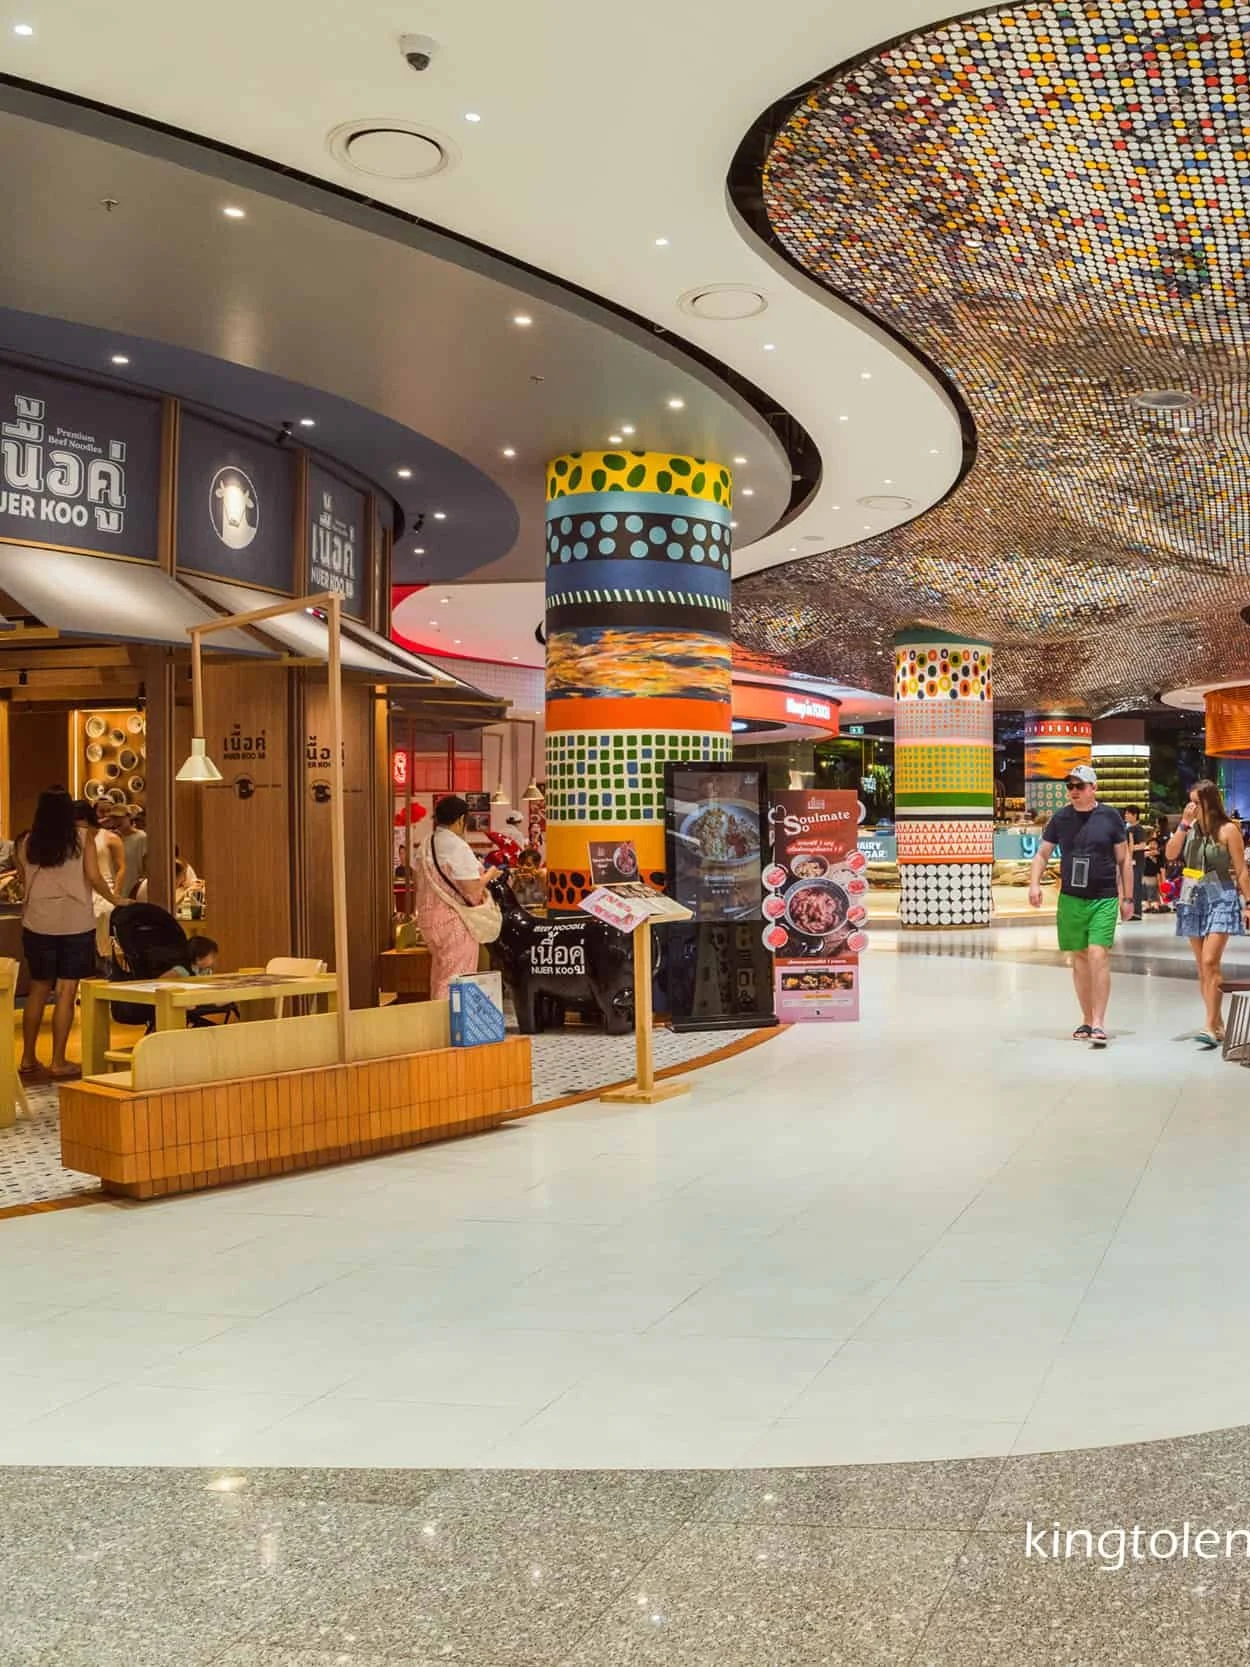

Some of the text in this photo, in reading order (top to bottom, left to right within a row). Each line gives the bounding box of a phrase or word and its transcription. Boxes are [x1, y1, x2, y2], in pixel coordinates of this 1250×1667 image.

[48, 435, 102, 453] Beef Noodles
[1, 394, 127, 533] นื้อคู่
[0, 490, 88, 527] UER KOO
[783, 811, 850, 836] Soulmate
[530, 930, 586, 976] เนื้อคู่
[530, 965, 575, 976] NUER KOO
